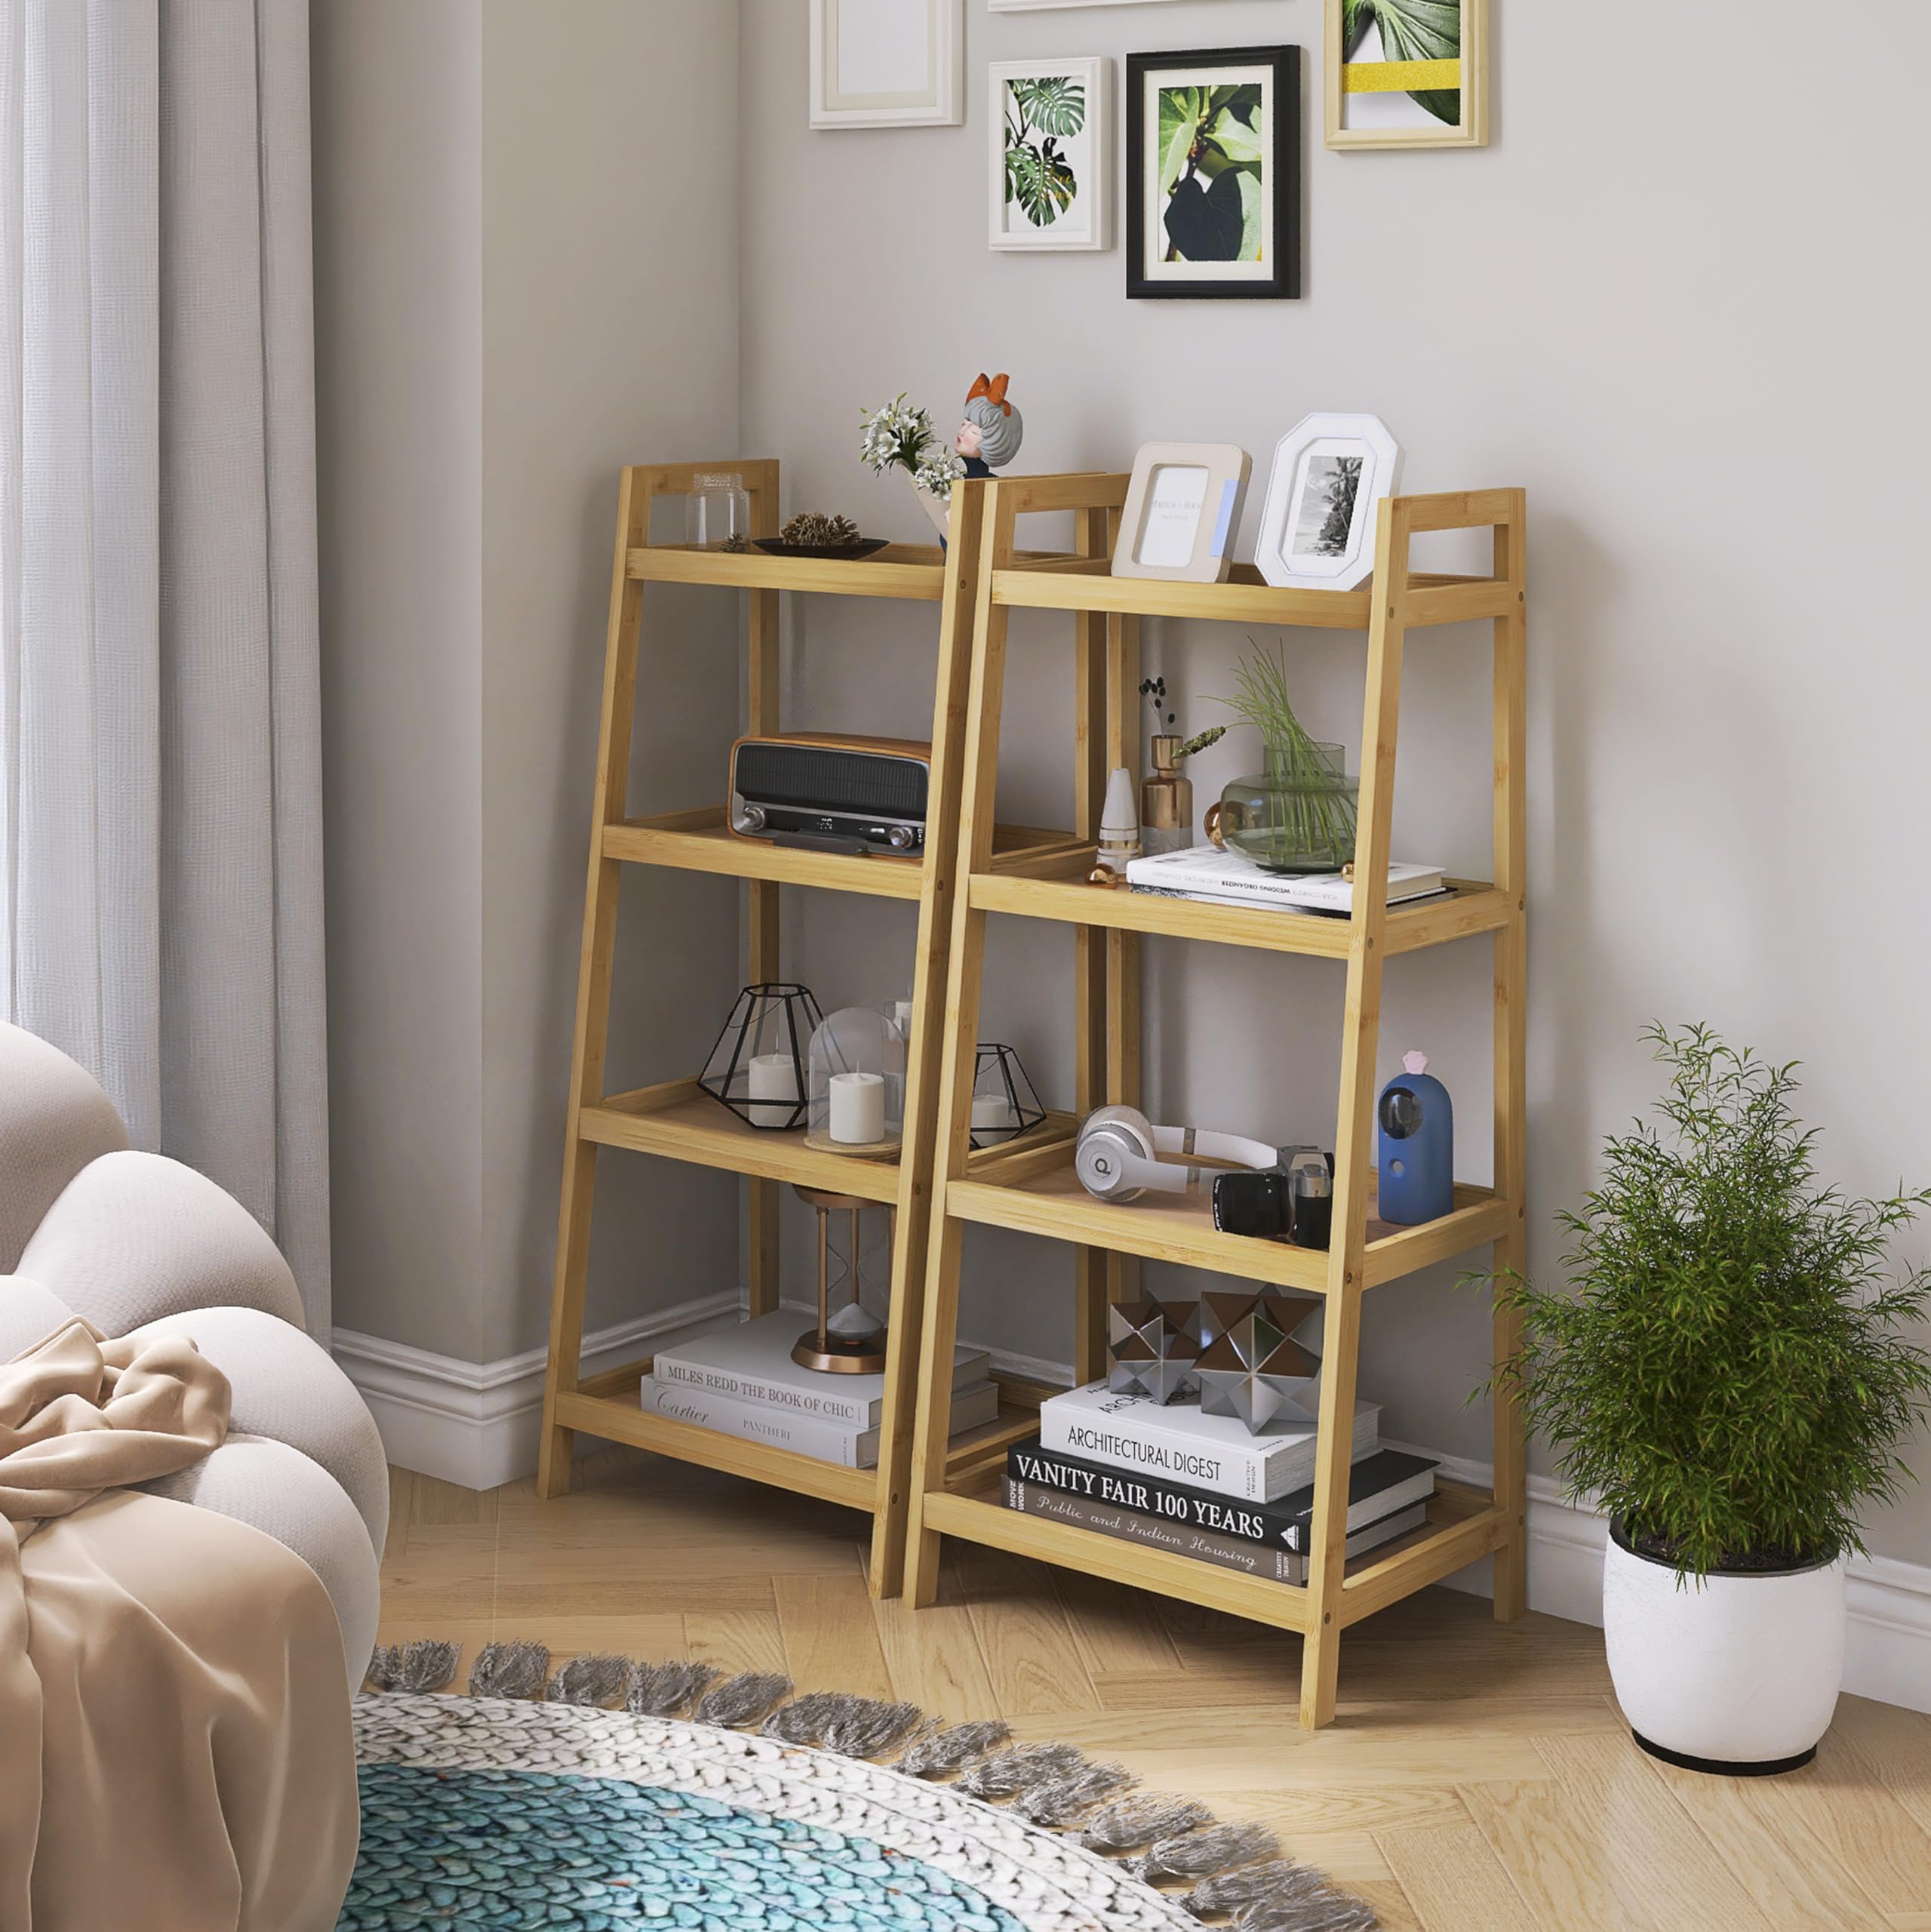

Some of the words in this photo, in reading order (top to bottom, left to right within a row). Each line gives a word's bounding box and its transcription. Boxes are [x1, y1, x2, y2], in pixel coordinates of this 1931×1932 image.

[1222, 880, 1258, 891] ORGANIZER
[1259, 884, 1291, 894] WEDDING
[653, 1385, 709, 1423] Cartier
[668, 1365, 703, 1384] MILES
[706, 1374, 738, 1392] REDD
[741, 1383, 765, 1398] THE
[768, 1389, 801, 1407] BOOK
[804, 1397, 820, 1411] OF
[823, 1401, 854, 1419] CHIC
[1068, 1425, 1170, 1469] ARCHITECTURAL
[1174, 1451, 1221, 1481] DIGEST
[1016, 1454, 1096, 1494] VANITY
[1100, 1476, 1150, 1510] FAIR
[1155, 1491, 1188, 1519] 100
[1192, 1500, 1264, 1539] YEARS
[1037, 1495, 1083, 1520] Public
[1090, 1516, 1121, 1529] and
[1127, 1519, 1182, 1546] Indian
[1190, 1536, 1257, 1571] Housing
